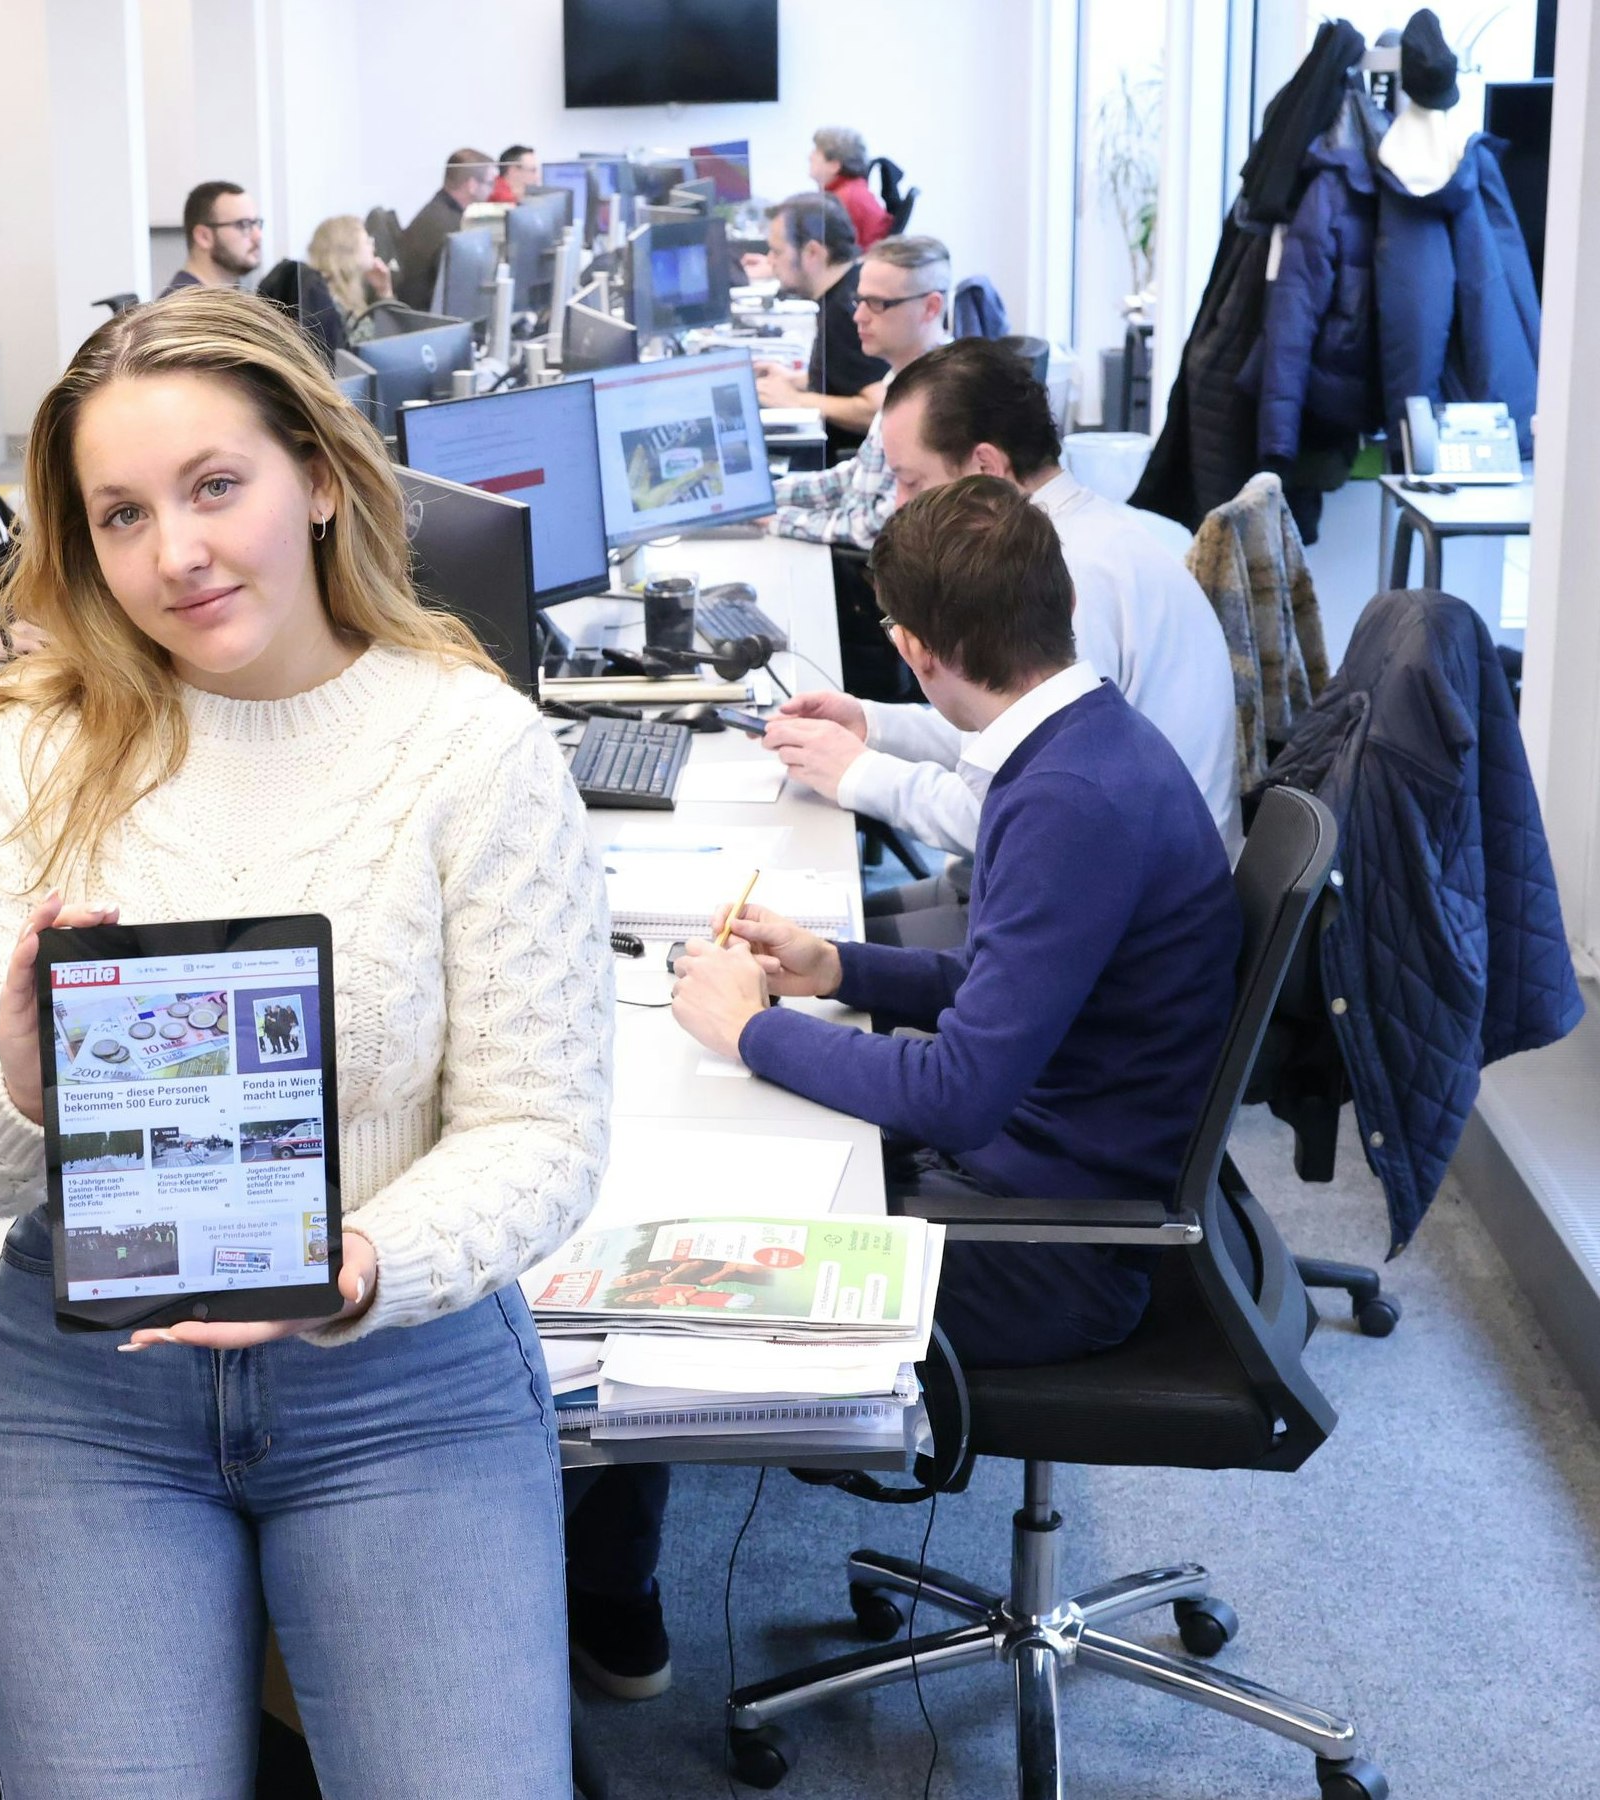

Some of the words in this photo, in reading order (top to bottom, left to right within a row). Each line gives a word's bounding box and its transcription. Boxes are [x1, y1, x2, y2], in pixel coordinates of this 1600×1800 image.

[55, 967, 116, 985] Heute
[142, 1044, 159, 1055] 10
[143, 1058, 161, 1069] 20
[72, 1067, 101, 1078] 200
[243, 1079, 275, 1089] Fonda
[277, 1078, 287, 1087] in
[290, 1077, 316, 1086] Wien
[64, 1090, 114, 1102] Teuerung
[127, 1088, 154, 1097] diese
[157, 1084, 208, 1095] Personen
[243, 1090, 276, 1101] macht
[279, 1089, 315, 1100] Lugner
[64, 1102, 123, 1113] bekommen
[126, 1099, 146, 1108] 500
[149, 1097, 173, 1107] Euro
[175, 1094, 211, 1105] zurück
[246, 1166, 291, 1175] Jugendlicher
[157, 1178, 202, 1187] Klima-Kleber
[68, 1184, 121, 1193] Casino-Besuch
[247, 1188, 273, 1196] Gesicht
[202, 1224, 216, 1232] Das
[236, 1222, 246, 1230] du
[248, 1221, 268, 1229] heute
[223, 1230, 272, 1240] Printausgabe
[218, 1251, 246, 1261] Heute
